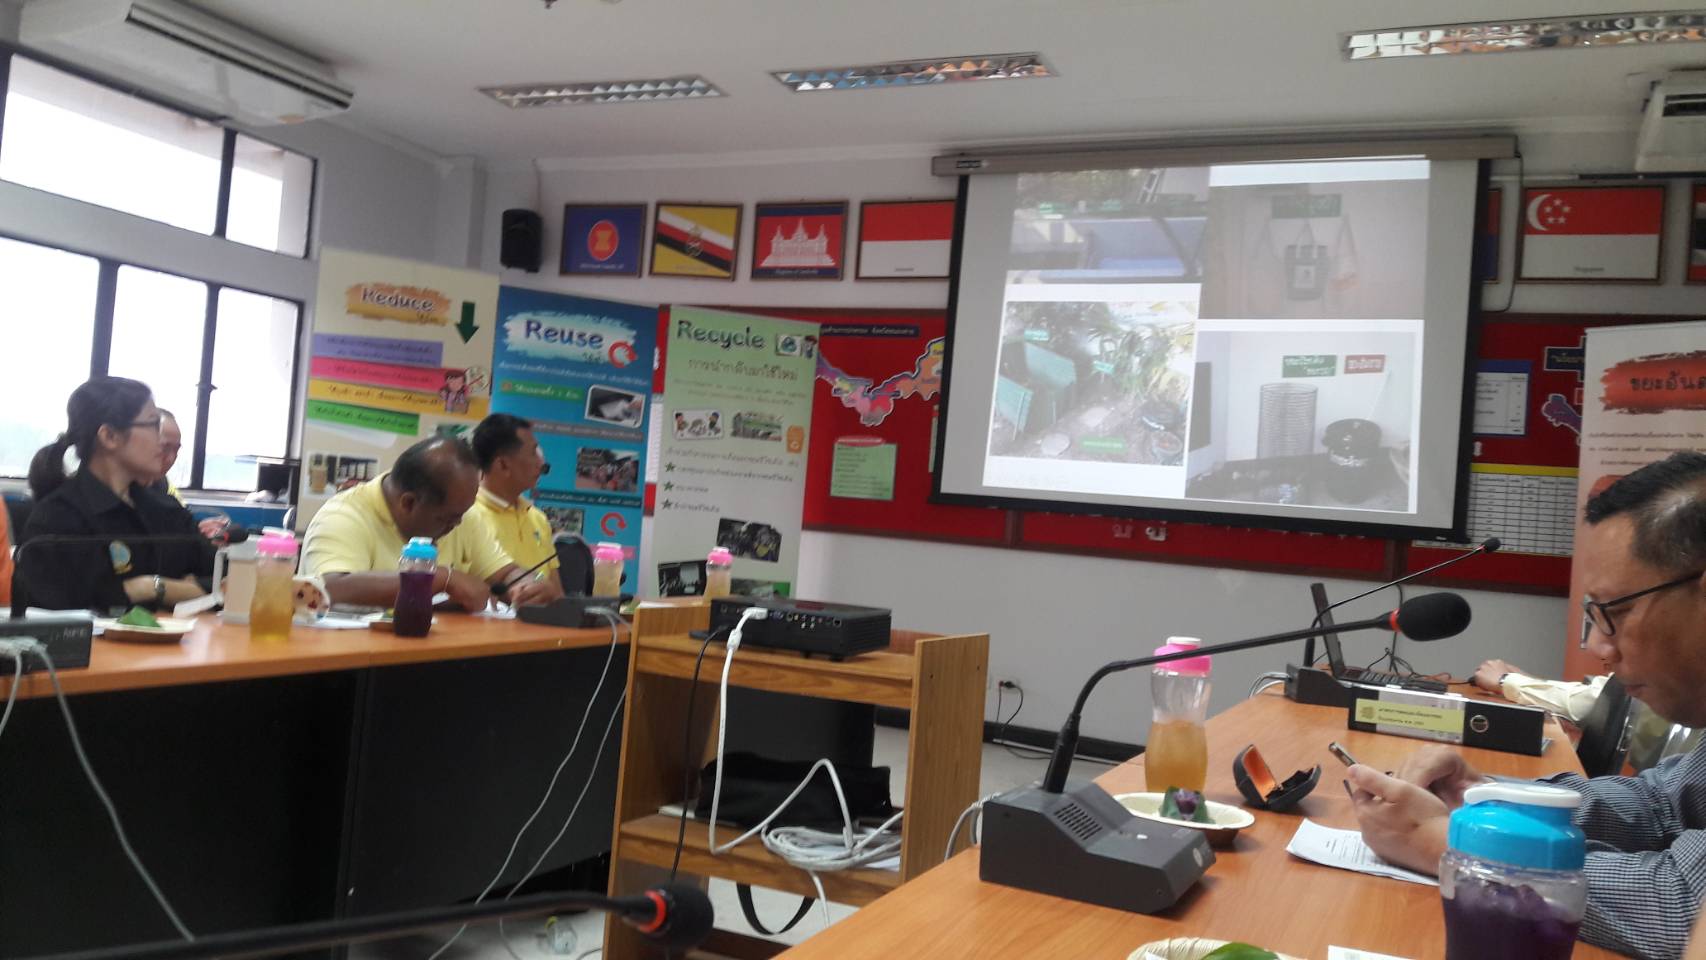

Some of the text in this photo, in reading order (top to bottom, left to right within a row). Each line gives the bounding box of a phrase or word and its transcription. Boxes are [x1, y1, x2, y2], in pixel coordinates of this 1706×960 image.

[361, 287, 435, 312] Reduce
[524, 318, 604, 350] Reuse
[676, 319, 767, 351] Recycle
